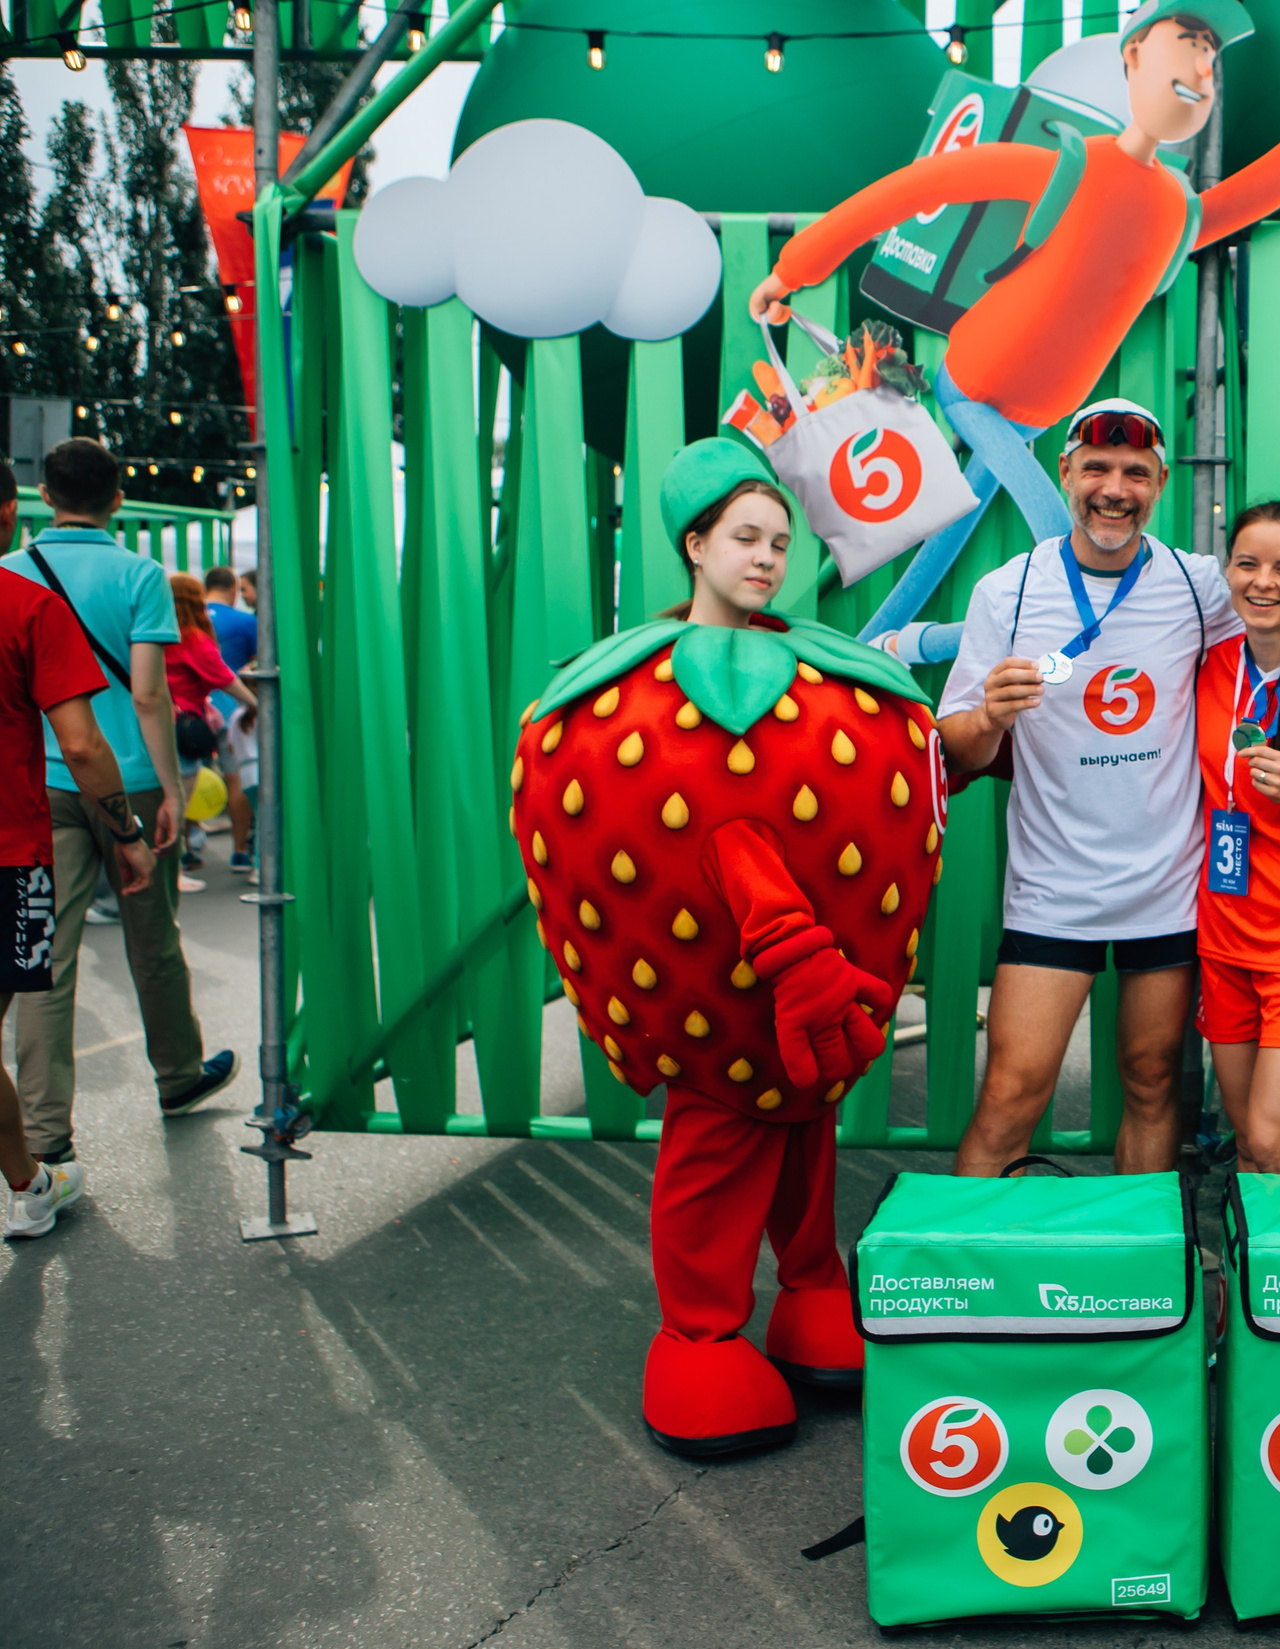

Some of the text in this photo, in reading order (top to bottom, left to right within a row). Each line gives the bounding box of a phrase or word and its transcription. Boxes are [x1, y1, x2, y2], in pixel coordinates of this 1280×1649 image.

[879, 226, 937, 274] Доставка
[846, 428, 904, 511] 5
[1101, 665, 1142, 726] 5
[1080, 748, 1162, 767] выручает!
[1216, 834, 1235, 875] 3
[1234, 837, 1243, 877] МЕСТО
[869, 1274, 995, 1293] Доставляем
[870, 1297, 968, 1315] продукты
[929, 1406, 981, 1478] 5
[1117, 1582, 1166, 1598] 25649
